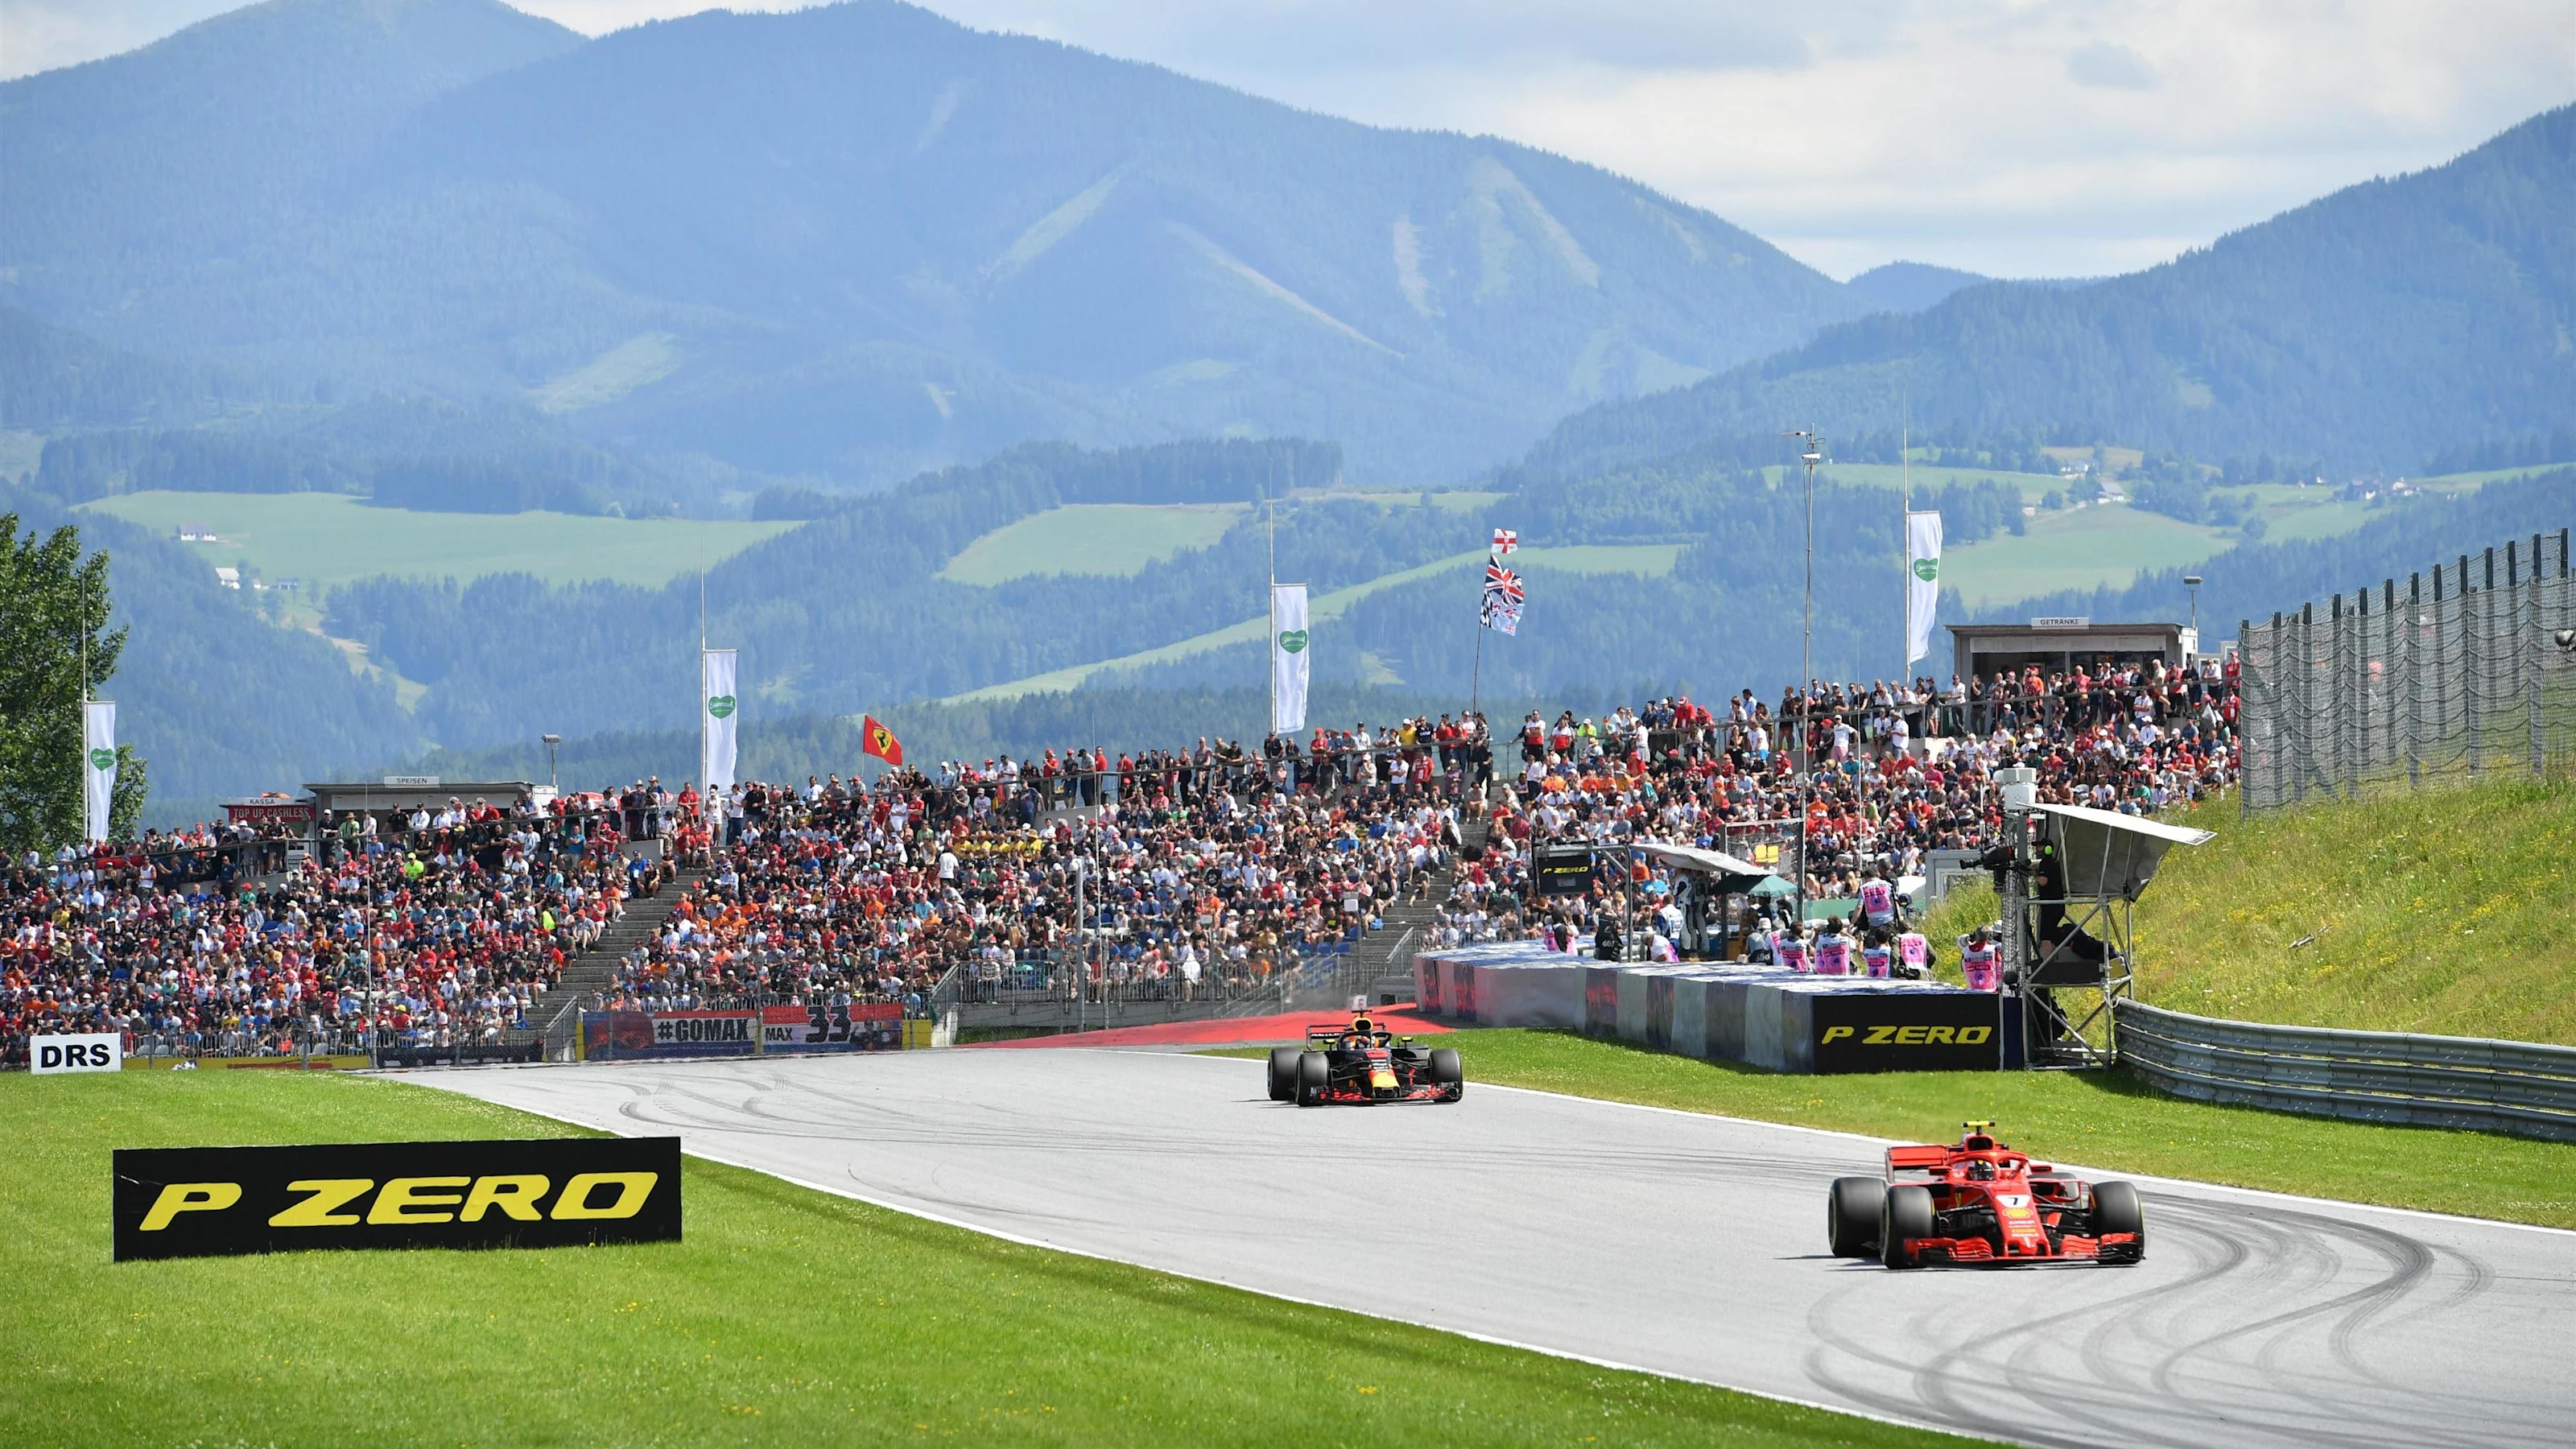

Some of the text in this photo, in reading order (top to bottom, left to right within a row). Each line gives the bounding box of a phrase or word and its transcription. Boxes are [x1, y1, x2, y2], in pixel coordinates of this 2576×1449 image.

[233, 807, 309, 819] TOP UP CASHLESS
[1554, 865, 1589, 874] ZERO
[658, 1018, 749, 1042] #GOMAX
[806, 1005, 851, 1043] 33
[765, 1027, 793, 1042] MAX
[1822, 1026, 1992, 1045] P ZERO
[40, 1043, 110, 1068] DRS
[139, 1171, 658, 1232] P ZERO
[2008, 1197, 2018, 1205] 7
